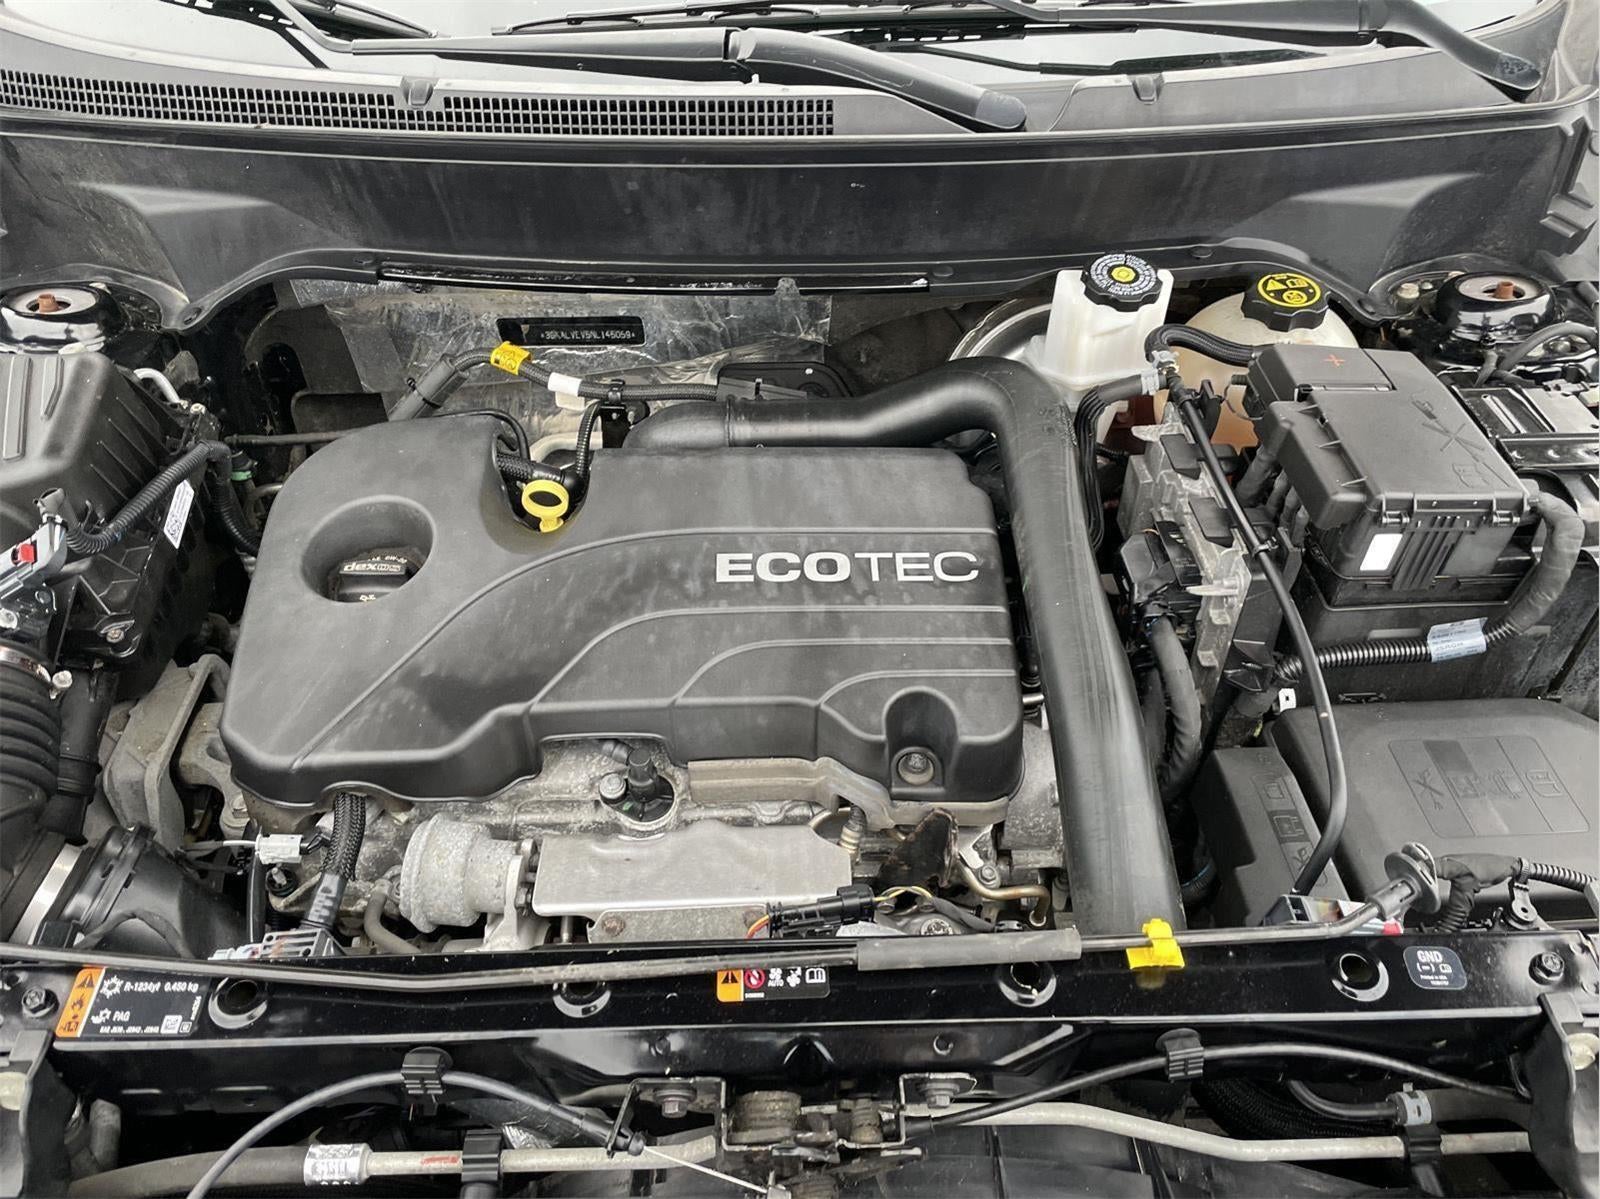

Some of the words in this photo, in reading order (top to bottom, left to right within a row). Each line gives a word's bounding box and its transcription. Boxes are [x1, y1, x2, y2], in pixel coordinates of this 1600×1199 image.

[343, 562, 402, 572] dexos
[716, 552, 979, 582] ECOTEC
[1417, 950, 1443, 963] GND
[164, 982, 187, 993] 0.450
[187, 982, 200, 994] kg
[113, 1011, 131, 1022] PAG
